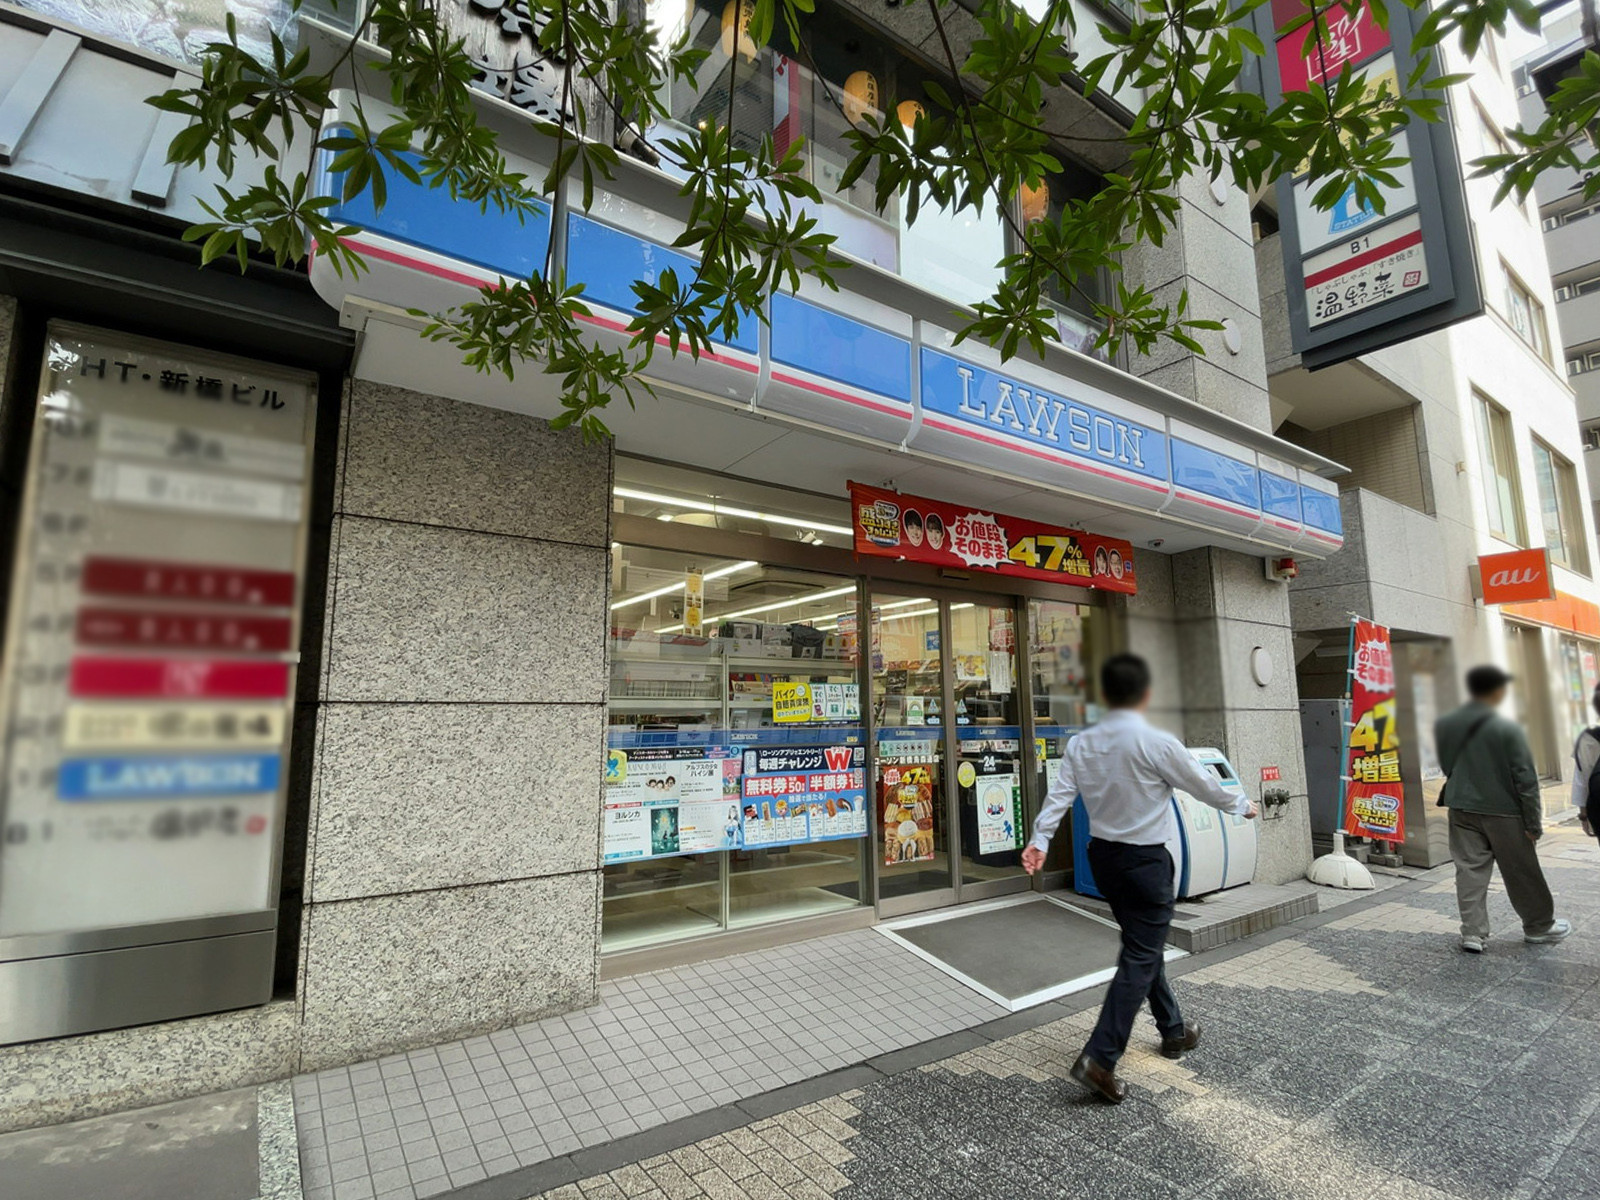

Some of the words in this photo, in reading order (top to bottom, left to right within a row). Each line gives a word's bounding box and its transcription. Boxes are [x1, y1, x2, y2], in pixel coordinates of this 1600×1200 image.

[1350, 237, 1371, 255] B1
[1315, 272, 1396, 319] 温野菜
[957, 366, 1145, 469] LAWSON
[954, 516, 1002, 542] お値段
[953, 540, 1007, 560] そのまま
[1489, 566, 1542, 588] au
[775, 689, 795, 699] バイク
[758, 755, 823, 771] 毎週チャレンジ
[825, 749, 852, 772] W
[983, 755, 996, 768] 24
[1351, 752, 1401, 784] 増量
[745, 776, 788, 796] 無料券
[810, 774, 849, 791] 半額券
